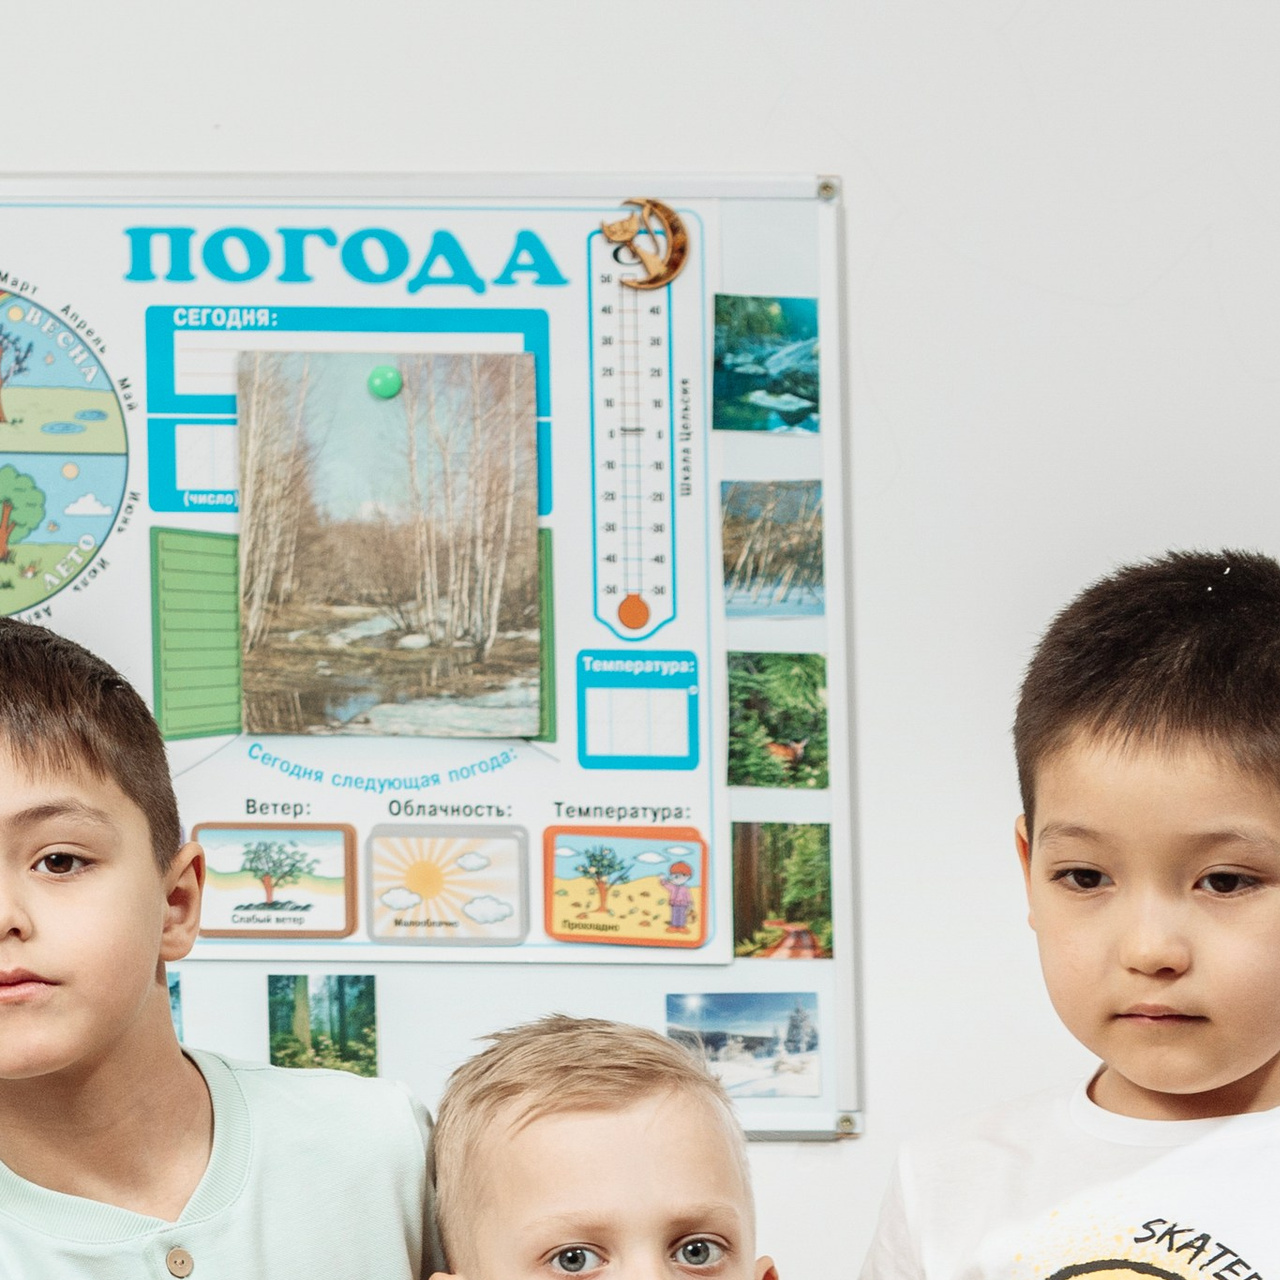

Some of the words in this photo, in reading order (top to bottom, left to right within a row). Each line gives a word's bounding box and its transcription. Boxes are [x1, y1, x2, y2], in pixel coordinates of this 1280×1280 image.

[123, 225, 570, 295] ПОГОДА
[61, 304, 107, 354] Апрель
[172, 306, 278, 329] СЕГОДНЯ:
[25, 306, 99, 384] ВЕСНА
[118, 376, 138, 412] Май
[680, 447, 692, 497] Шкала
[117, 491, 141, 533] Июнь
[43, 534, 95, 592] ЛЕТО
[73, 557, 110, 592] Июль
[582, 656, 695, 676] Температура:
[247, 743, 325, 783] Сегодня
[331, 772, 441, 795] следующая
[448, 747, 518, 784] погода:
[245, 798, 311, 819] Ветер:
[388, 799, 513, 818] Облачность:
[553, 801, 692, 823] Температура:
